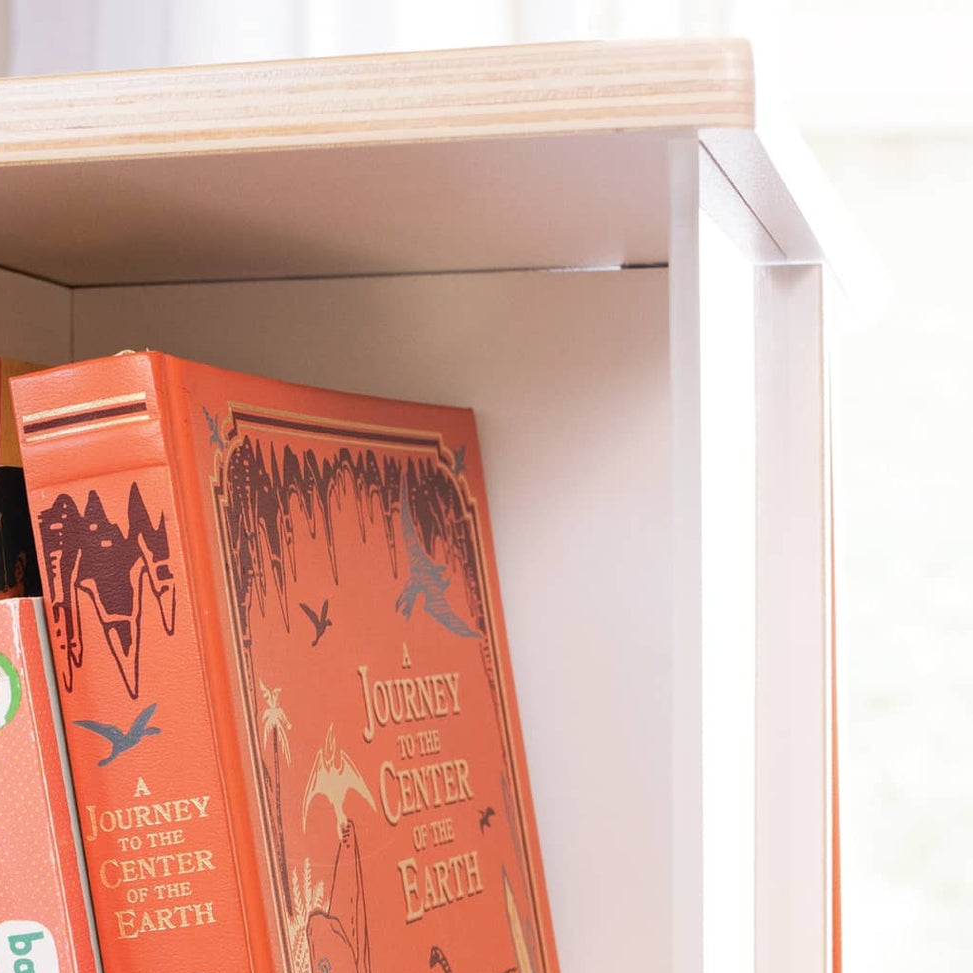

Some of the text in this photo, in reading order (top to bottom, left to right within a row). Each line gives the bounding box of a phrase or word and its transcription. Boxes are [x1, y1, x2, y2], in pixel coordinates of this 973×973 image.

[402, 642, 411, 669] A
[357, 665, 461, 744] JOURNEY
[397, 729, 441, 761] TO THE
[133, 777, 151, 797] A
[379, 758, 475, 827] CENTER
[86, 796, 211, 842] JOURNEY
[413, 818, 455, 851] OF THE
[118, 830, 185, 851] TO THE
[99, 850, 216, 889] CENTER
[397, 850, 484, 925] EARTH
[127, 882, 192, 904] OF THE
[115, 901, 217, 940] EARTH
